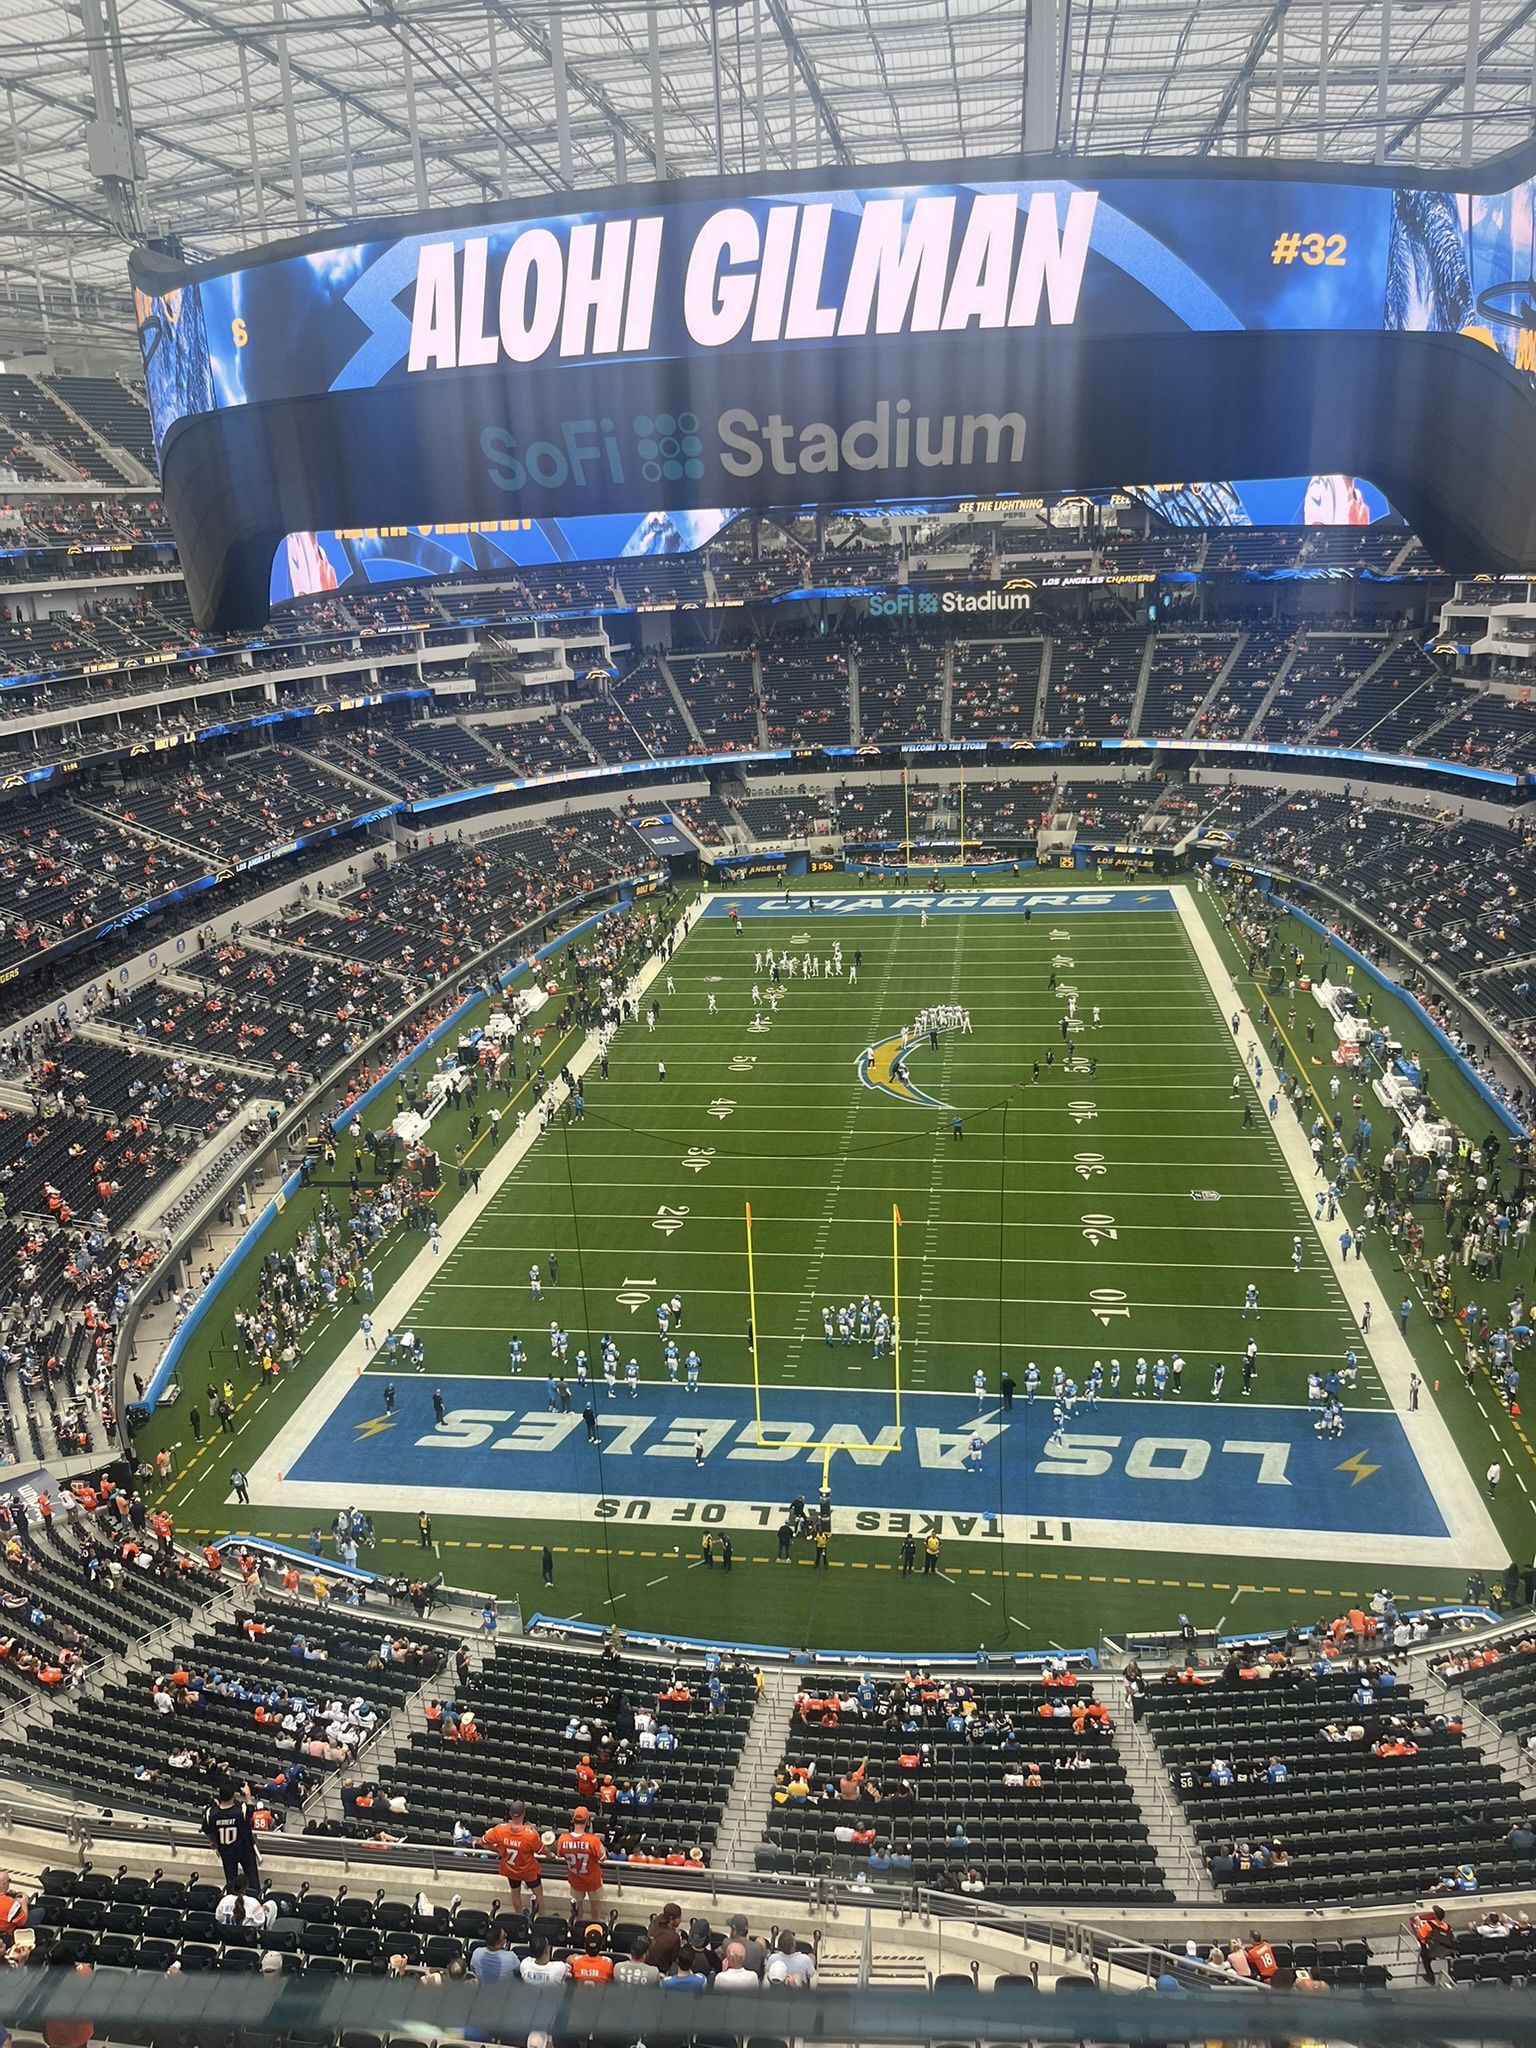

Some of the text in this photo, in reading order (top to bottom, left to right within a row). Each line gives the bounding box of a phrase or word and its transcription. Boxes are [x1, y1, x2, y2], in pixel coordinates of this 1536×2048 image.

[1271, 232, 1347, 266] #32
[407, 190, 1099, 372] ALOHI GILMAN
[231, 318, 248, 348] S
[479, 398, 1028, 492] SoFi Stadium
[958, 499, 1044, 513] SEE THE LIGHTNING
[917, 516, 940, 524] PEPSI
[1042, 575, 1156, 586] LOS ANGELES CHARGERS
[869, 589, 1030, 616] SoFi Stadium
[901, 742, 988, 753] WELCOME TO THE STORM
[750, 864, 788, 875] ANGELES
[1097, 857, 1114, 865] LOS
[636, 882, 657, 896] BOLT UP
[756, 893, 1117, 915] CHARGERS
[728, 1055, 758, 1071] 50
[706, 1097, 738, 1116] 40
[1067, 1100, 1099, 1120] 40
[681, 1146, 716, 1168] 30
[1073, 1152, 1107, 1175] 30
[651, 1204, 690, 1231] 20
[1080, 1213, 1118, 1241] 20
[615, 1276, 658, 1305] 10
[1089, 1288, 1131, 1319] 10
[414, 1408, 1294, 1487] LOS ANGELES
[594, 1498, 651, 1520] US
[671, 1503, 727, 1526] OF
[855, 1511, 1005, 1538] TAKES
[1030, 1520, 1072, 1542] IT
[972, 1727, 985, 1738] 85
[1180, 1777, 1193, 1788] 56
[1219, 1777, 1228, 1786] 10
[255, 1818, 266, 1828] 58
[218, 1827, 238, 1845] 10
[503, 1838, 522, 1847] ELWAY
[562, 1841, 590, 1850] ATWATER
[506, 1848, 519, 1866] 7
[564, 1853, 590, 1874] 27
[1260, 1952, 1273, 1968] 18
[580, 1968, 600, 1977] WILSON
